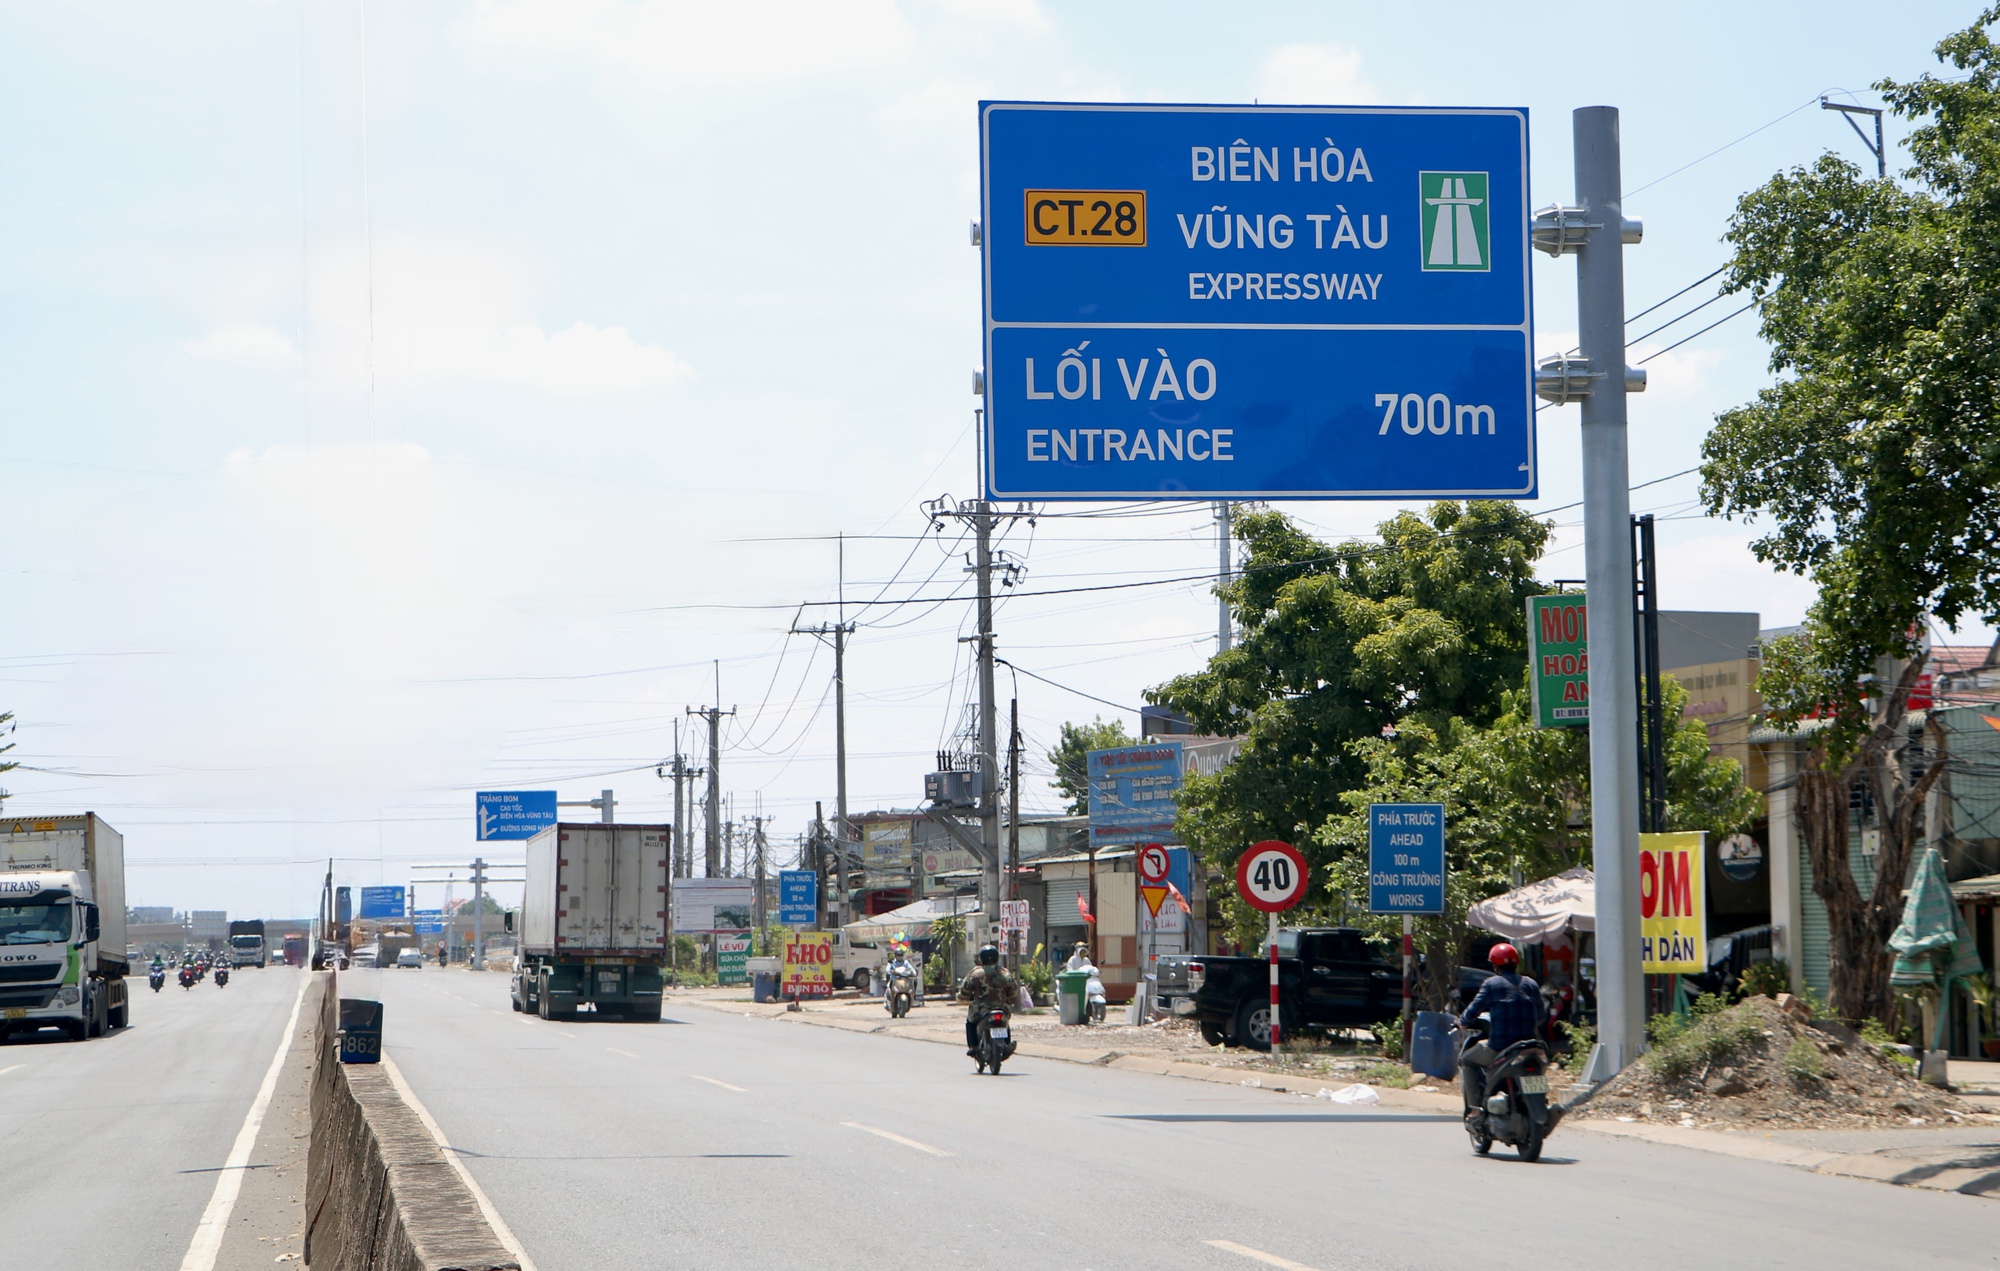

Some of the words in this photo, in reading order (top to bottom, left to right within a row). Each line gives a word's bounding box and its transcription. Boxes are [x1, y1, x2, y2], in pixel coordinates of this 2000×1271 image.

[1191, 138, 1279, 182] BIÊN
[1293, 137, 1374, 183] HÒA
[1032, 199, 1138, 237] CT.28
[1176, 206, 1294, 249] VŨNG
[1306, 204, 1388, 250] TÀU
[1188, 273, 1383, 300] EXPRESSWAY
[1025, 340, 1101, 401] LỐI
[1116, 348, 1217, 401] VÀO
[1374, 393, 1496, 436] 700m
[1026, 428, 1234, 462] ENTRANCE
[1540, 605, 1587, 644] MOT
[1543, 647, 1588, 677] HOÀ
[1378, 810, 1401, 826] PHÍA
[1403, 810, 1436, 826] TRƯỚC
[1390, 833, 1424, 846] AHEAD
[1254, 858, 1290, 891] 40
[1394, 854, 1408, 866] 100
[1410, 856, 1420, 866] m
[1373, 870, 1399, 886] CÔNG
[1402, 870, 1441, 886] TRƯỜNG
[1640, 850, 1693, 919] ƠM
[1389, 894, 1424, 906] WORKS
[3, 954, 37, 962] OWO
[1659, 930, 1694, 961] DÂN
